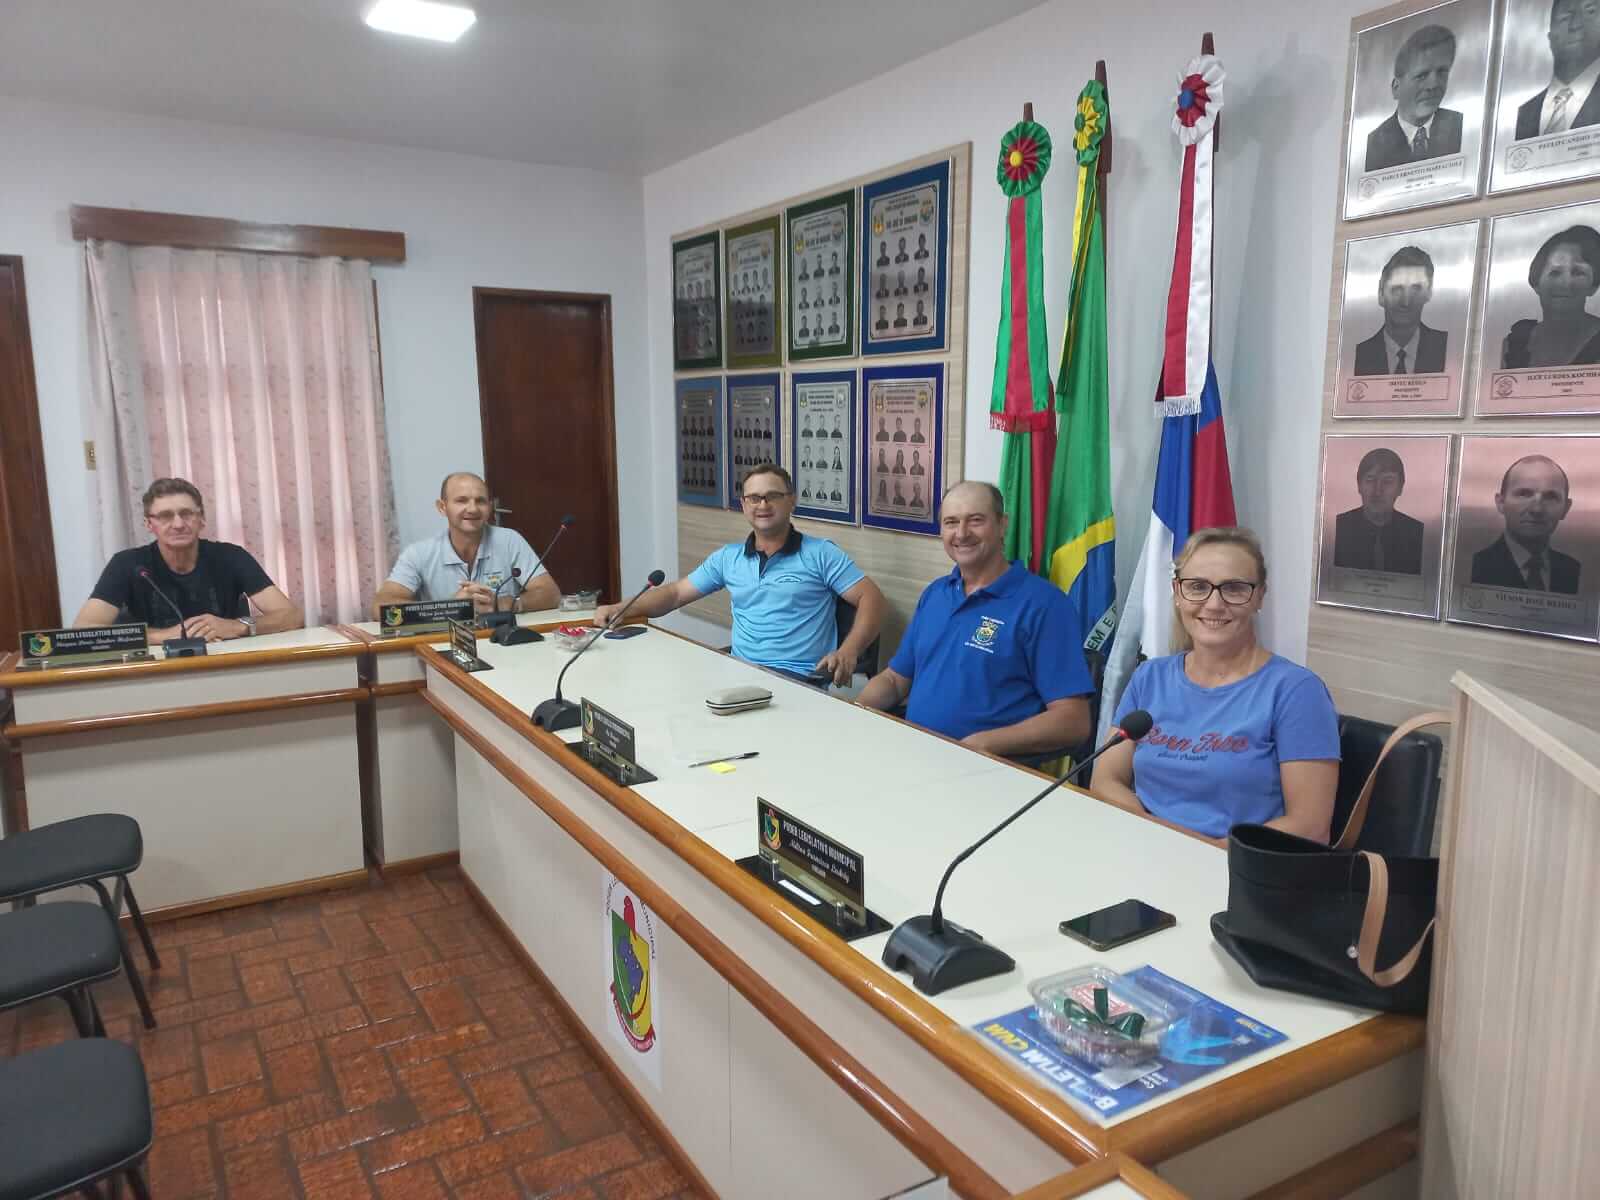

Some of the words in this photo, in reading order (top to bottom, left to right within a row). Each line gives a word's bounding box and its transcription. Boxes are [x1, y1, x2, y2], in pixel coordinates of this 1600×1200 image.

[76, 630, 111, 639] LEGISLATIVO
[112, 628, 142, 636] MUNICIPAL
[783, 820, 798, 837] PODER
[798, 828, 828, 857] LEGISLATIVO
[828, 845, 857, 872] MUNICIPAL
[982, 1023, 1029, 1051] CNM
[1019, 1049, 1120, 1110] BLETIM
